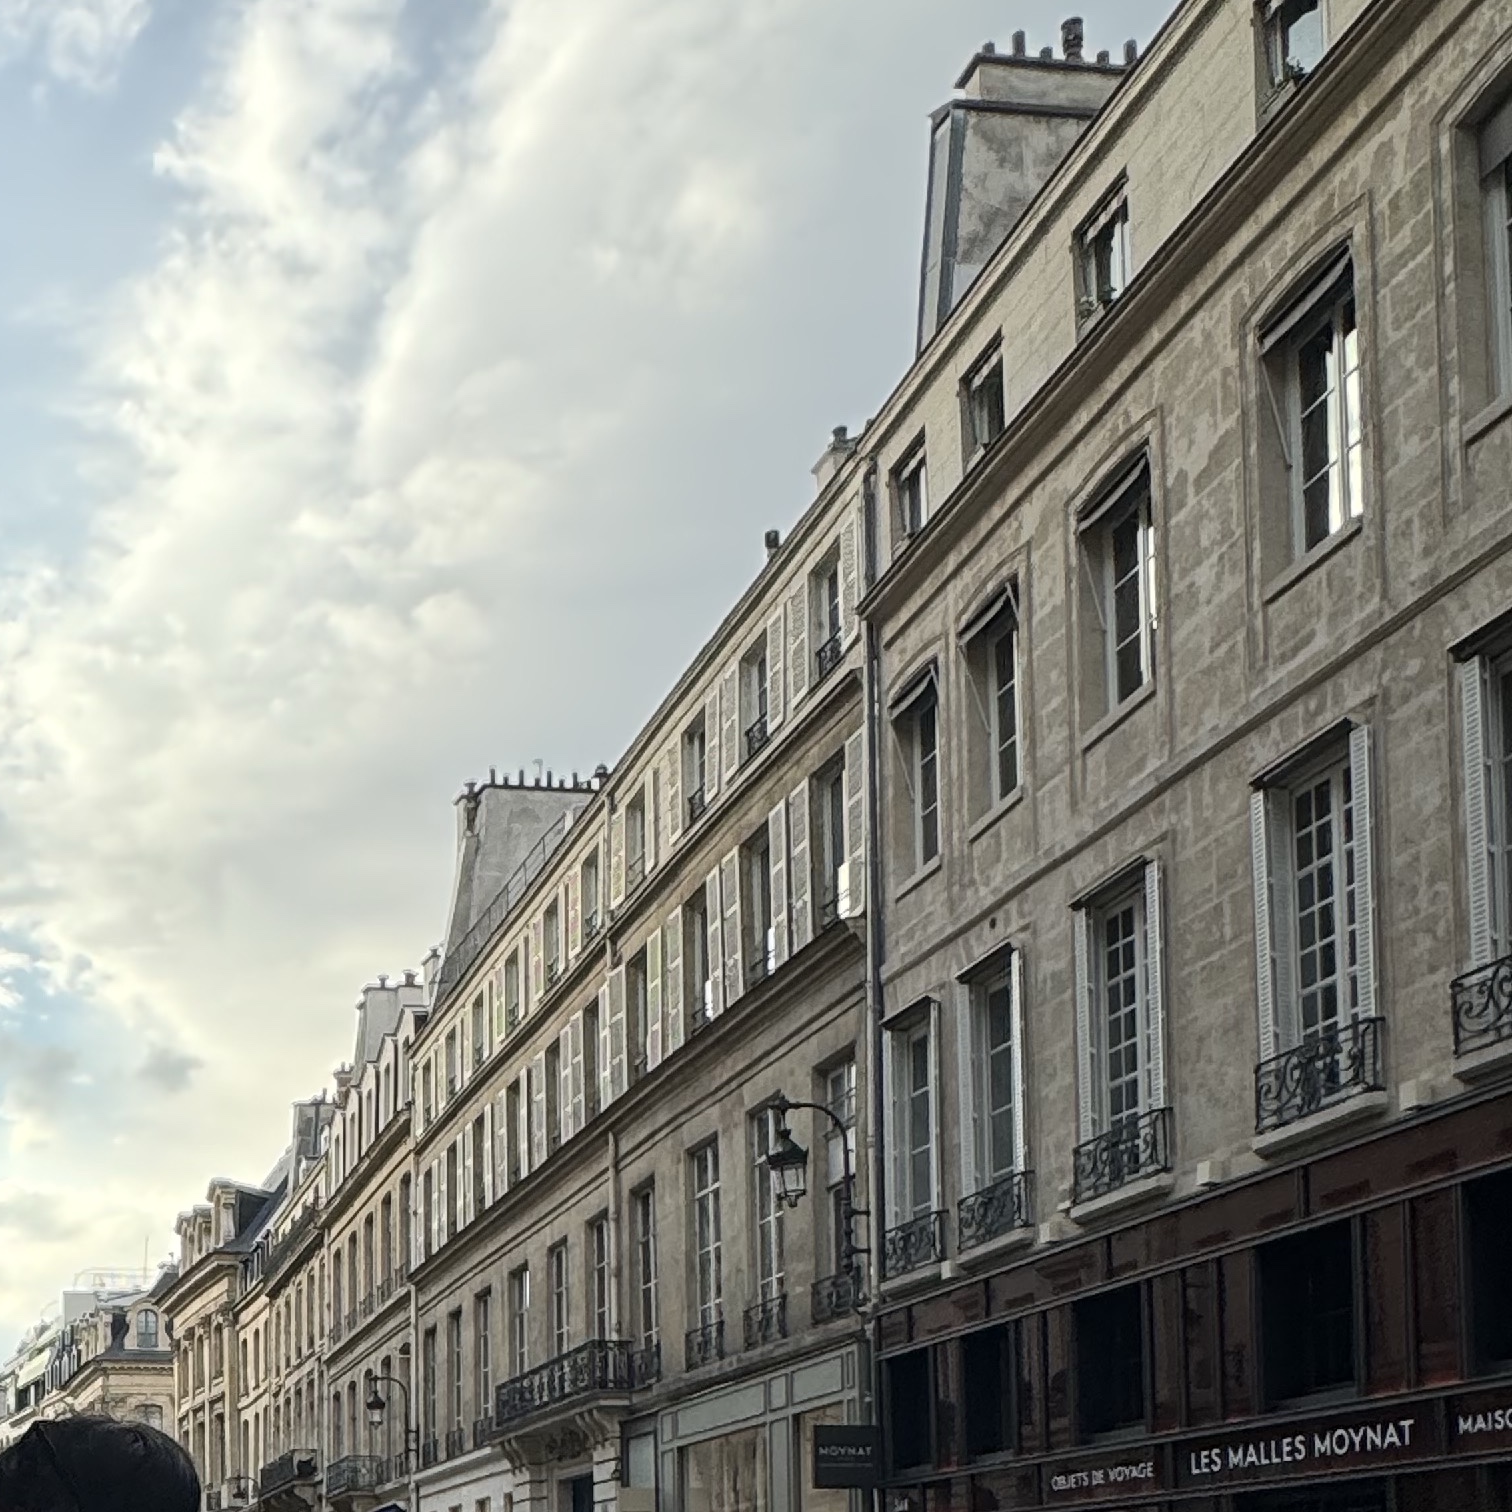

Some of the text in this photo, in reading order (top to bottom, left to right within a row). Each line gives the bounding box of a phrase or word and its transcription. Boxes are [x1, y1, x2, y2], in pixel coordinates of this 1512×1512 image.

[818, 1445, 872, 1457] MOYNAT
[1190, 1419, 1415, 1475] LES MALLES MOYNAT
[1091, 1469, 1105, 1485] DE
[1107, 1462, 1154, 1482] VOYAGE
